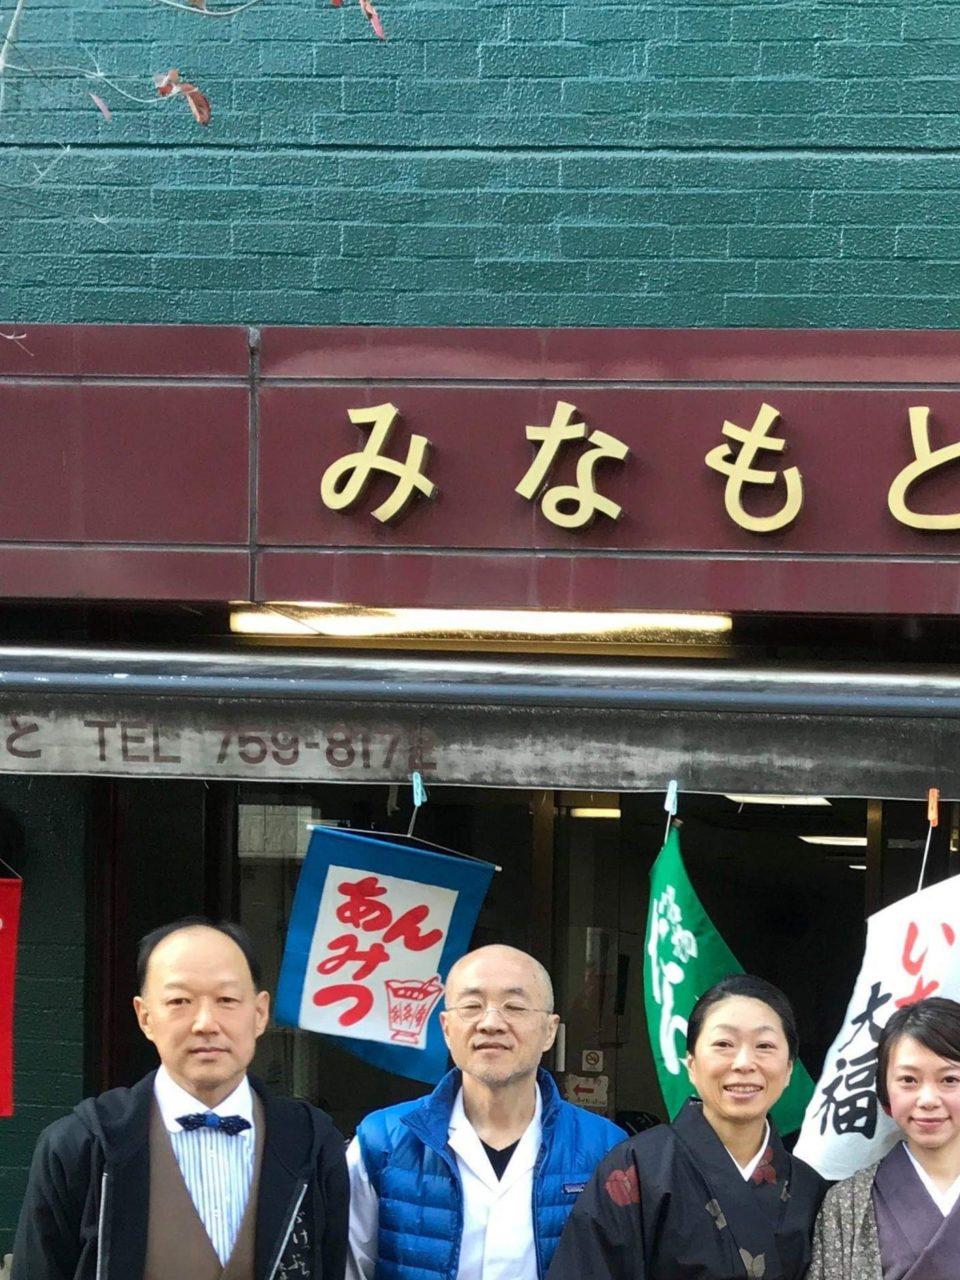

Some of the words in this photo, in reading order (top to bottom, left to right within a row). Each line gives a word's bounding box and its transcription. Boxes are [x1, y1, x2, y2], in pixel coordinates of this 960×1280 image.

[84, 720, 181, 763] TEL
[313, 876, 443, 1027] あんみつ
[813, 981, 893, 1140] 大福
